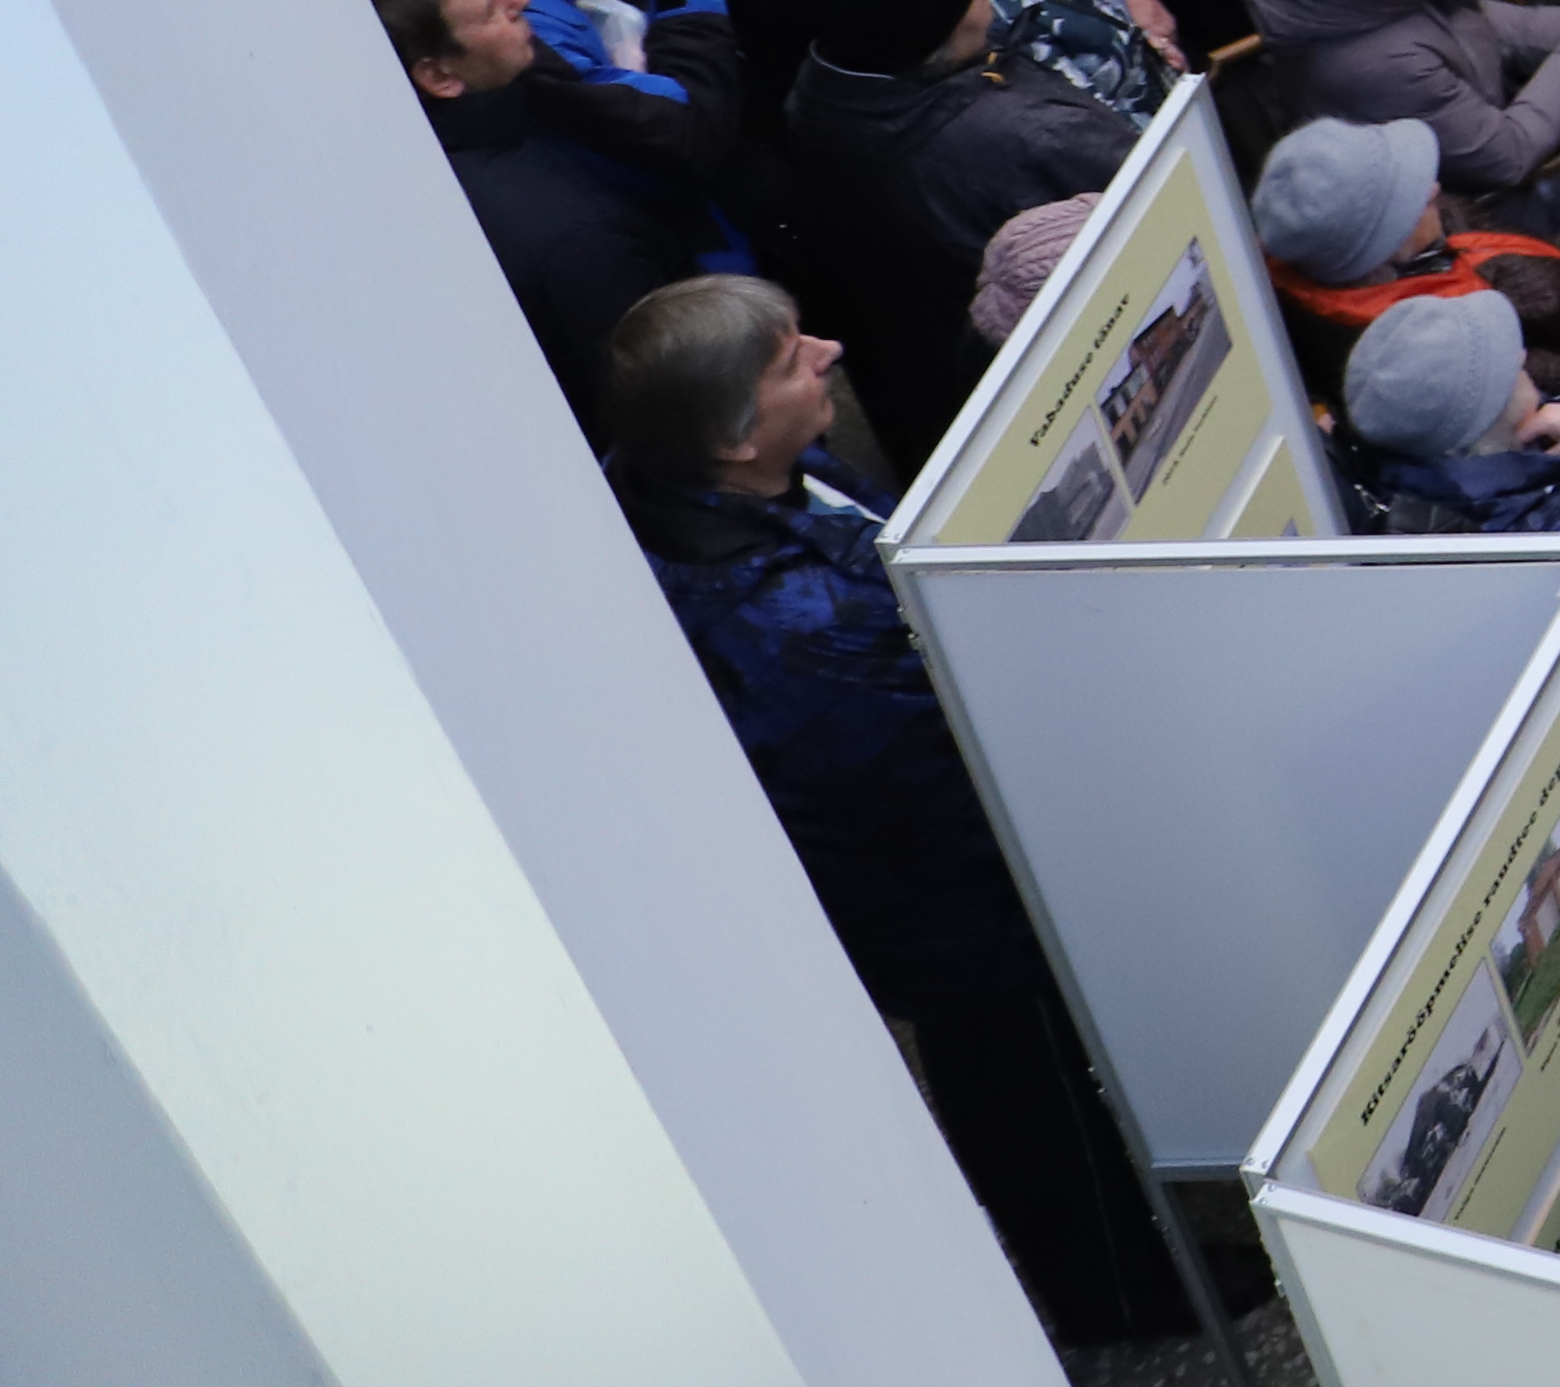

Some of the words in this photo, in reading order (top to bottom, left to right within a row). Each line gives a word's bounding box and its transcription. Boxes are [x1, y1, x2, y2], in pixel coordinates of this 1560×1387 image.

[1030, 351, 1094, 447] Vabaduse
[1094, 293, 1129, 349] tänav
[1483, 809, 1537, 907] raudtee
